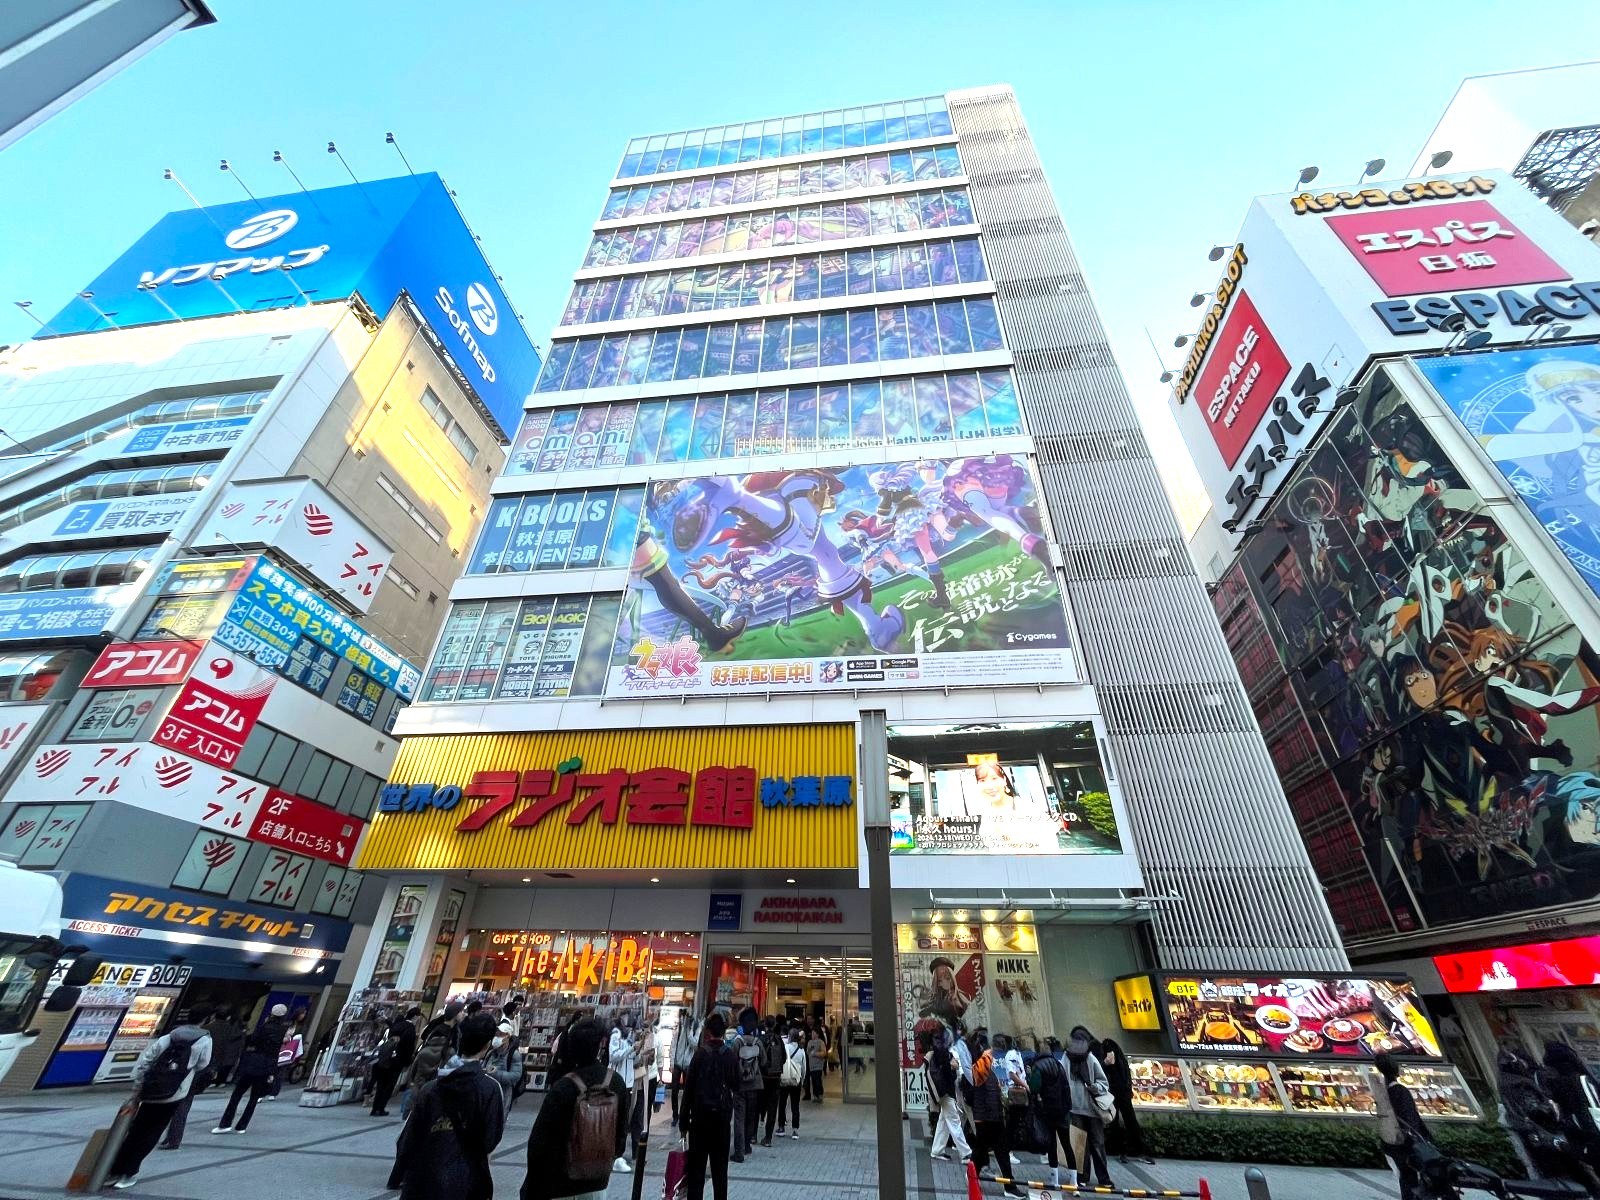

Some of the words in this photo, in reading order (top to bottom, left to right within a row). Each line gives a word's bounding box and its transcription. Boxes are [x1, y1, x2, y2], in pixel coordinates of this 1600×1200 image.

[1356, 220, 1516, 254] エスパス
[137, 244, 330, 290] ソフマップ
[1419, 251, 1497, 273] 日拓
[435, 286, 496, 383] Softmap
[1174, 312, 1219, 405] PACHINKO
[1216, 242, 1249, 308] SLOT
[1207, 325, 1260, 424] ESPACE
[164, 429, 243, 447] 中古専門店
[524, 429, 628, 450] amami
[1222, 362, 1331, 530] エスパス
[65, 509, 90, 530] 2F
[516, 530, 574, 546] 秋葉原
[482, 545, 598, 566] 本館&MENS館
[907, 570, 1052, 655] 伝説となる
[1015, 632, 1057, 642] Cygames
[93, 649, 187, 679] アコム
[711, 663, 812, 686] 好評配信中!
[184, 689, 246, 734] アコム
[160, 724, 192, 743] 3F
[189, 733, 221, 760] 入口
[377, 783, 462, 811] 世界の
[455, 756, 758, 832] ラジオ会館
[760, 776, 852, 809] 秋葉原
[268, 797, 292, 816] 2F
[258, 819, 332, 853] 店舗入口こちら
[760, 897, 837, 909] AKIHABARA
[105, 893, 302, 938] アクセスチケット
[754, 911, 843, 924] RADIOKAIKAN
[68, 920, 109, 934] ACCESS
[111, 925, 143, 937] TICKET
[492, 933, 517, 945] GIFT
[519, 932, 551, 945] SHOP
[511, 946, 550, 976] The
[996, 958, 1031, 974] NIKKE
[1176, 983, 1195, 994] B1F
